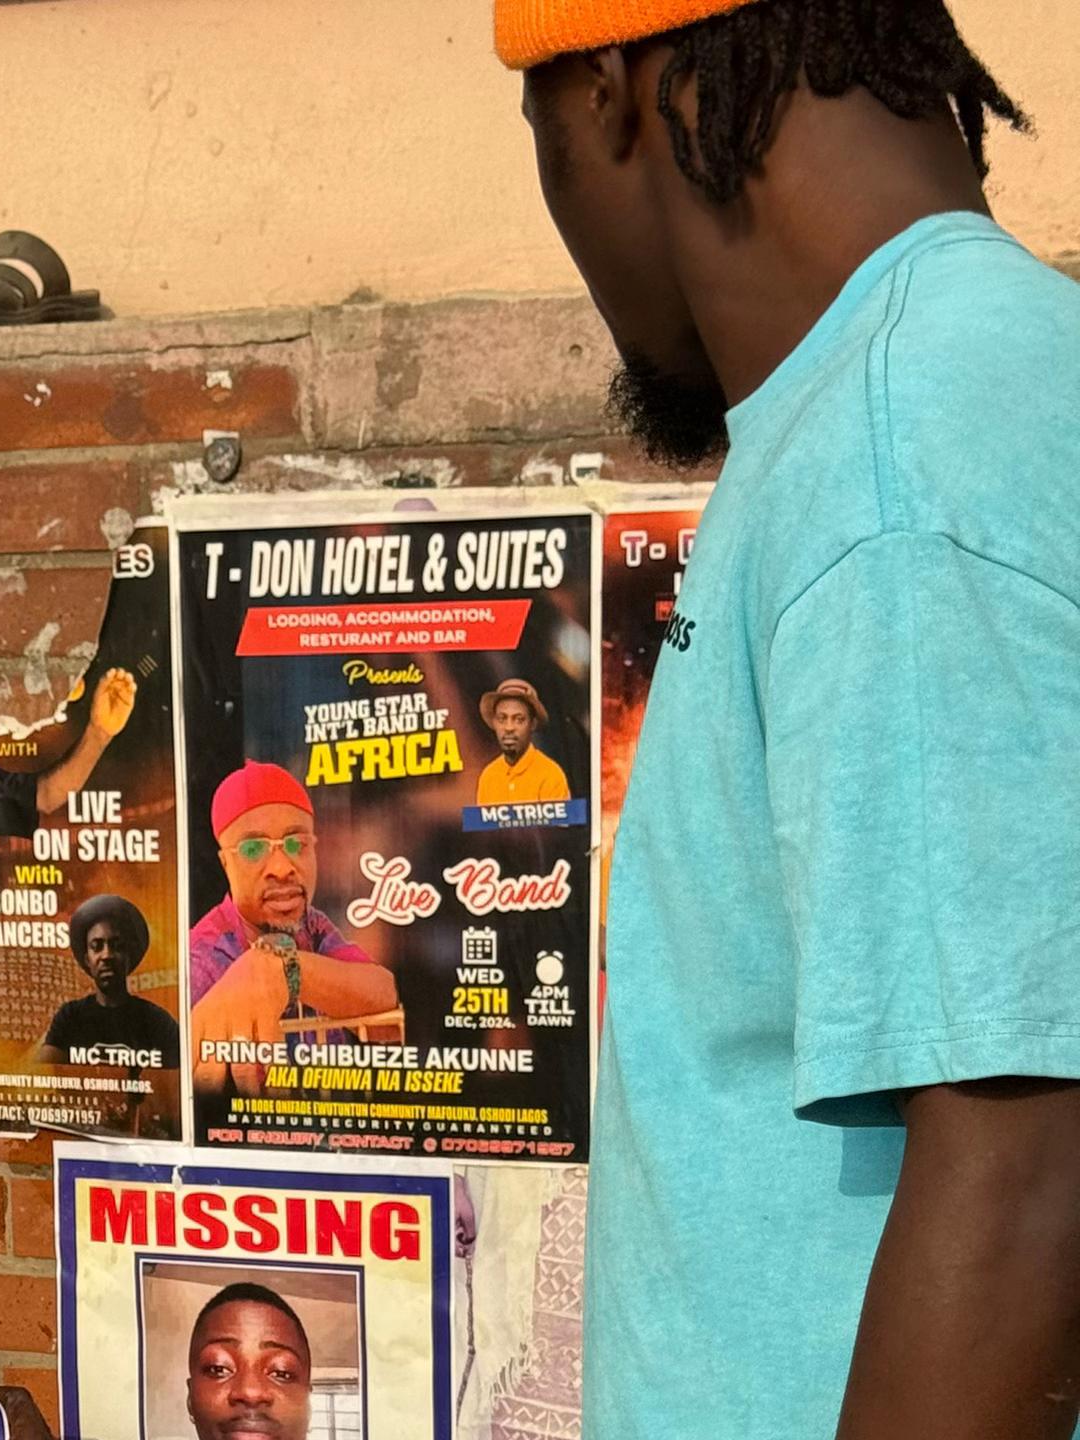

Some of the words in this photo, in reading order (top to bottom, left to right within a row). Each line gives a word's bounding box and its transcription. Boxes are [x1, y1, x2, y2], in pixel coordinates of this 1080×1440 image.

[206, 542, 224, 599] T
[249, 539, 315, 598] DON
[321, 535, 414, 596] HOTEL
[422, 533, 448, 592] &
[454, 528, 567, 592] SUITES
[268, 613, 342, 628] LODGING,
[345, 608, 496, 625] ACCOMMODATION,
[300, 632, 392, 647] RESTURANT
[396, 630, 430, 644] AND
[434, 629, 466, 643] BAR
[342, 660, 423, 685] Presents
[304, 699, 370, 724] YOUNG
[375, 693, 428, 717] STAR
[305, 720, 358, 743] INT'L
[363, 714, 417, 737] BAND
[423, 709, 449, 730] OF
[306, 729, 463, 787] AFRICA
[68, 791, 122, 823] LIVE
[481, 806, 510, 822] MC
[513, 803, 567, 819] TRICE
[33, 828, 69, 861] ON
[78, 828, 160, 862] STAGE
[15, 865, 63, 885] With
[347, 852, 441, 928] Live
[443, 858, 571, 916] Band
[456, 968, 504, 984] WED
[453, 987, 508, 1014] 25TH
[531, 985, 569, 999] 4PM
[524, 998, 576, 1015] TILL
[444, 1015, 477, 1030] DEC,
[527, 1015, 573, 1027] DAWN
[70, 1047, 99, 1065] MC
[101, 1048, 162, 1068] TRICE
[200, 1040, 287, 1065] PRINCE
[294, 1043, 418, 1069] CHIBUEZE
[425, 1047, 534, 1072] AKUNNE
[266, 1068, 298, 1089] AKA
[302, 1068, 371, 1091] OFUNWA
[376, 1070, 398, 1091] NA
[405, 1071, 464, 1094] ISSEKE
[370, 1103, 425, 1119] COMMUNITY
[517, 1108, 548, 1124] LAGOS
[228, 1114, 312, 1126] MAXIMUM
[320, 1118, 415, 1131] SECURITY
[423, 1122, 553, 1136] GUARANTEED
[207, 1128, 243, 1142] FOR
[327, 1133, 414, 1149] CONTACT
[89, 1186, 421, 1261] MISSING
